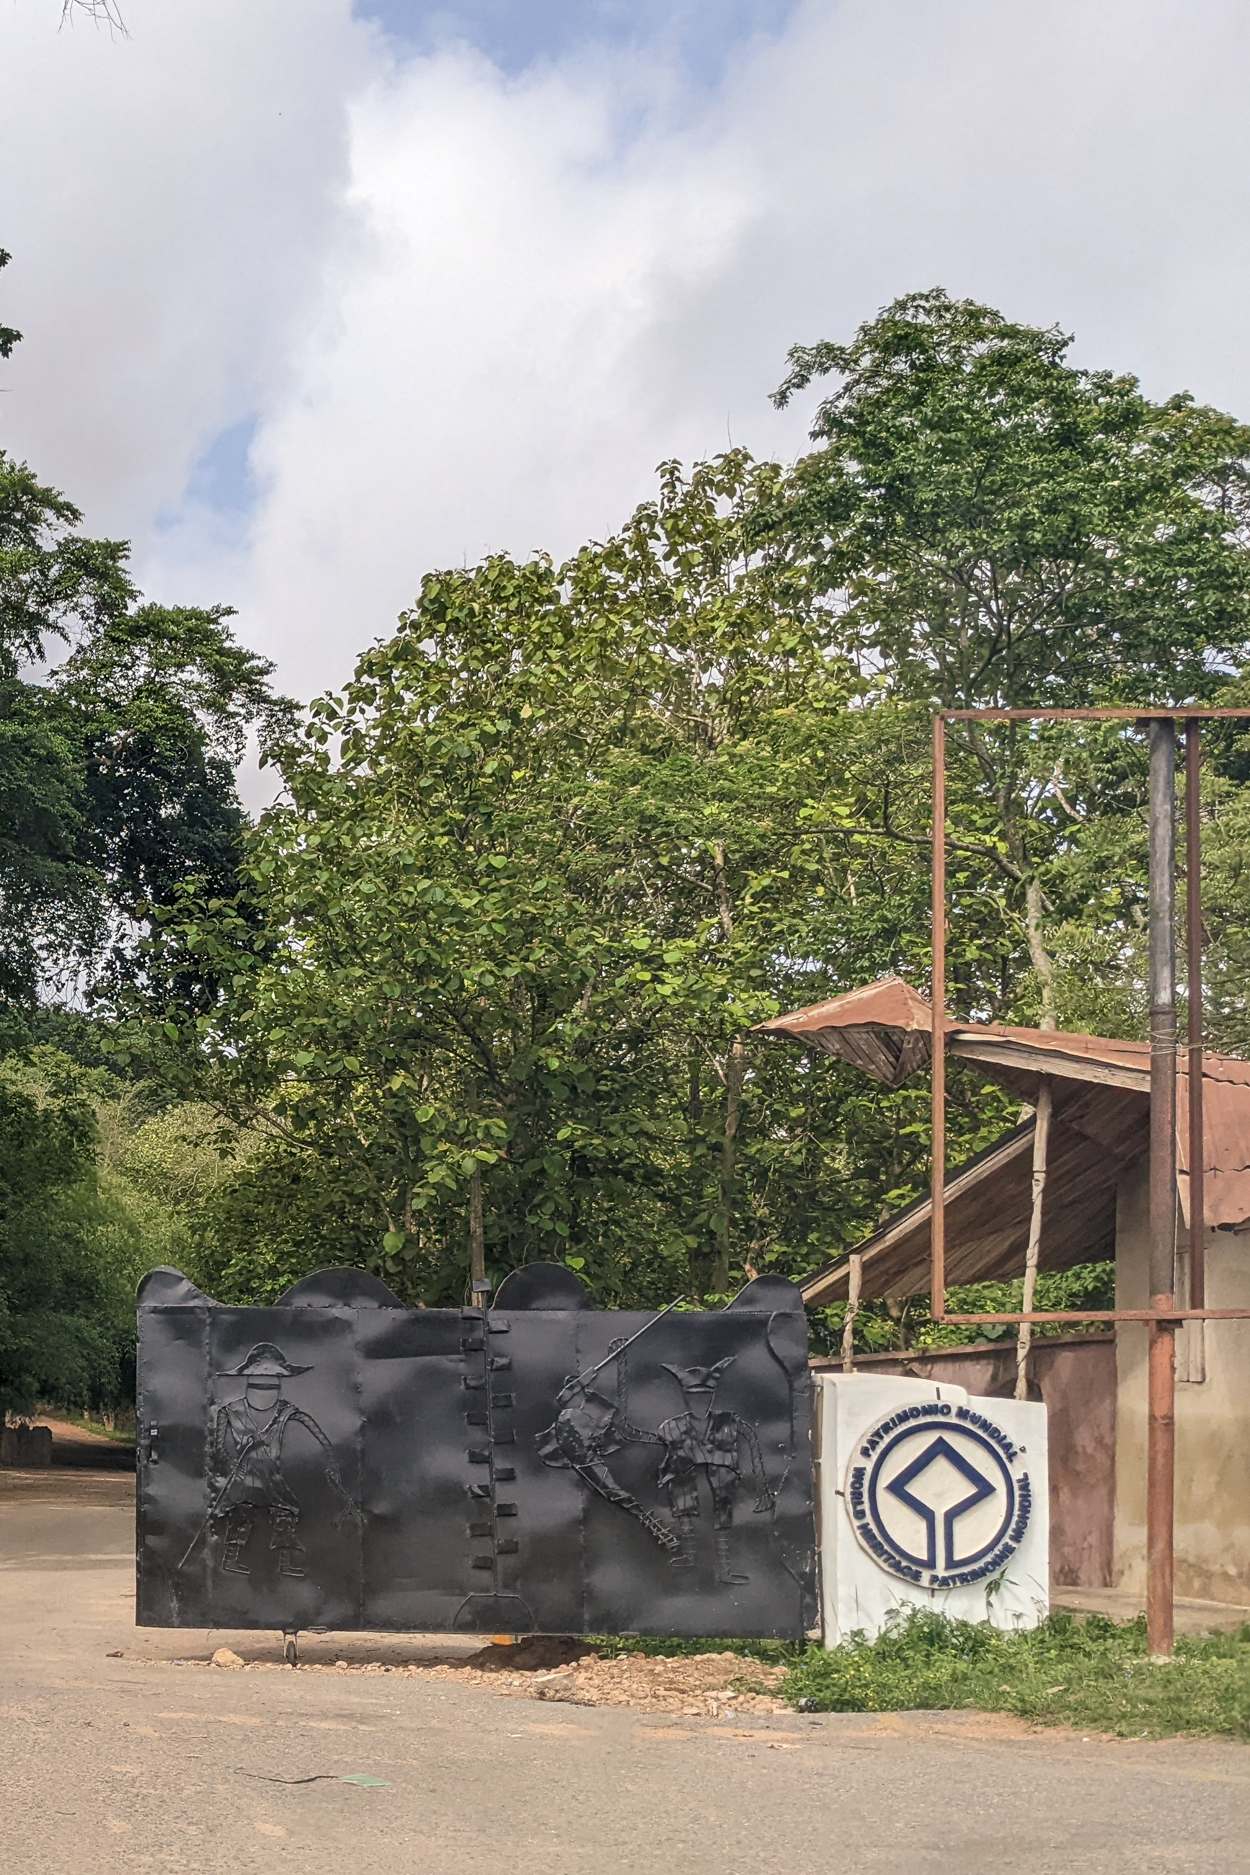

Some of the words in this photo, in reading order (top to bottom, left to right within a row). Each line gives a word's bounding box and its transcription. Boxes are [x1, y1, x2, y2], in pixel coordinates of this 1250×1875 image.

[860, 1404, 951, 1458] PATRIMONIO
[955, 1406, 1018, 1463] MUNDIAL
[850, 1467, 866, 1520] WORLD
[857, 1522, 923, 1582] HERITAGE
[929, 1542, 1016, 1587] PATRIMOINE
[1009, 1472, 1031, 1543] MONDIAL
